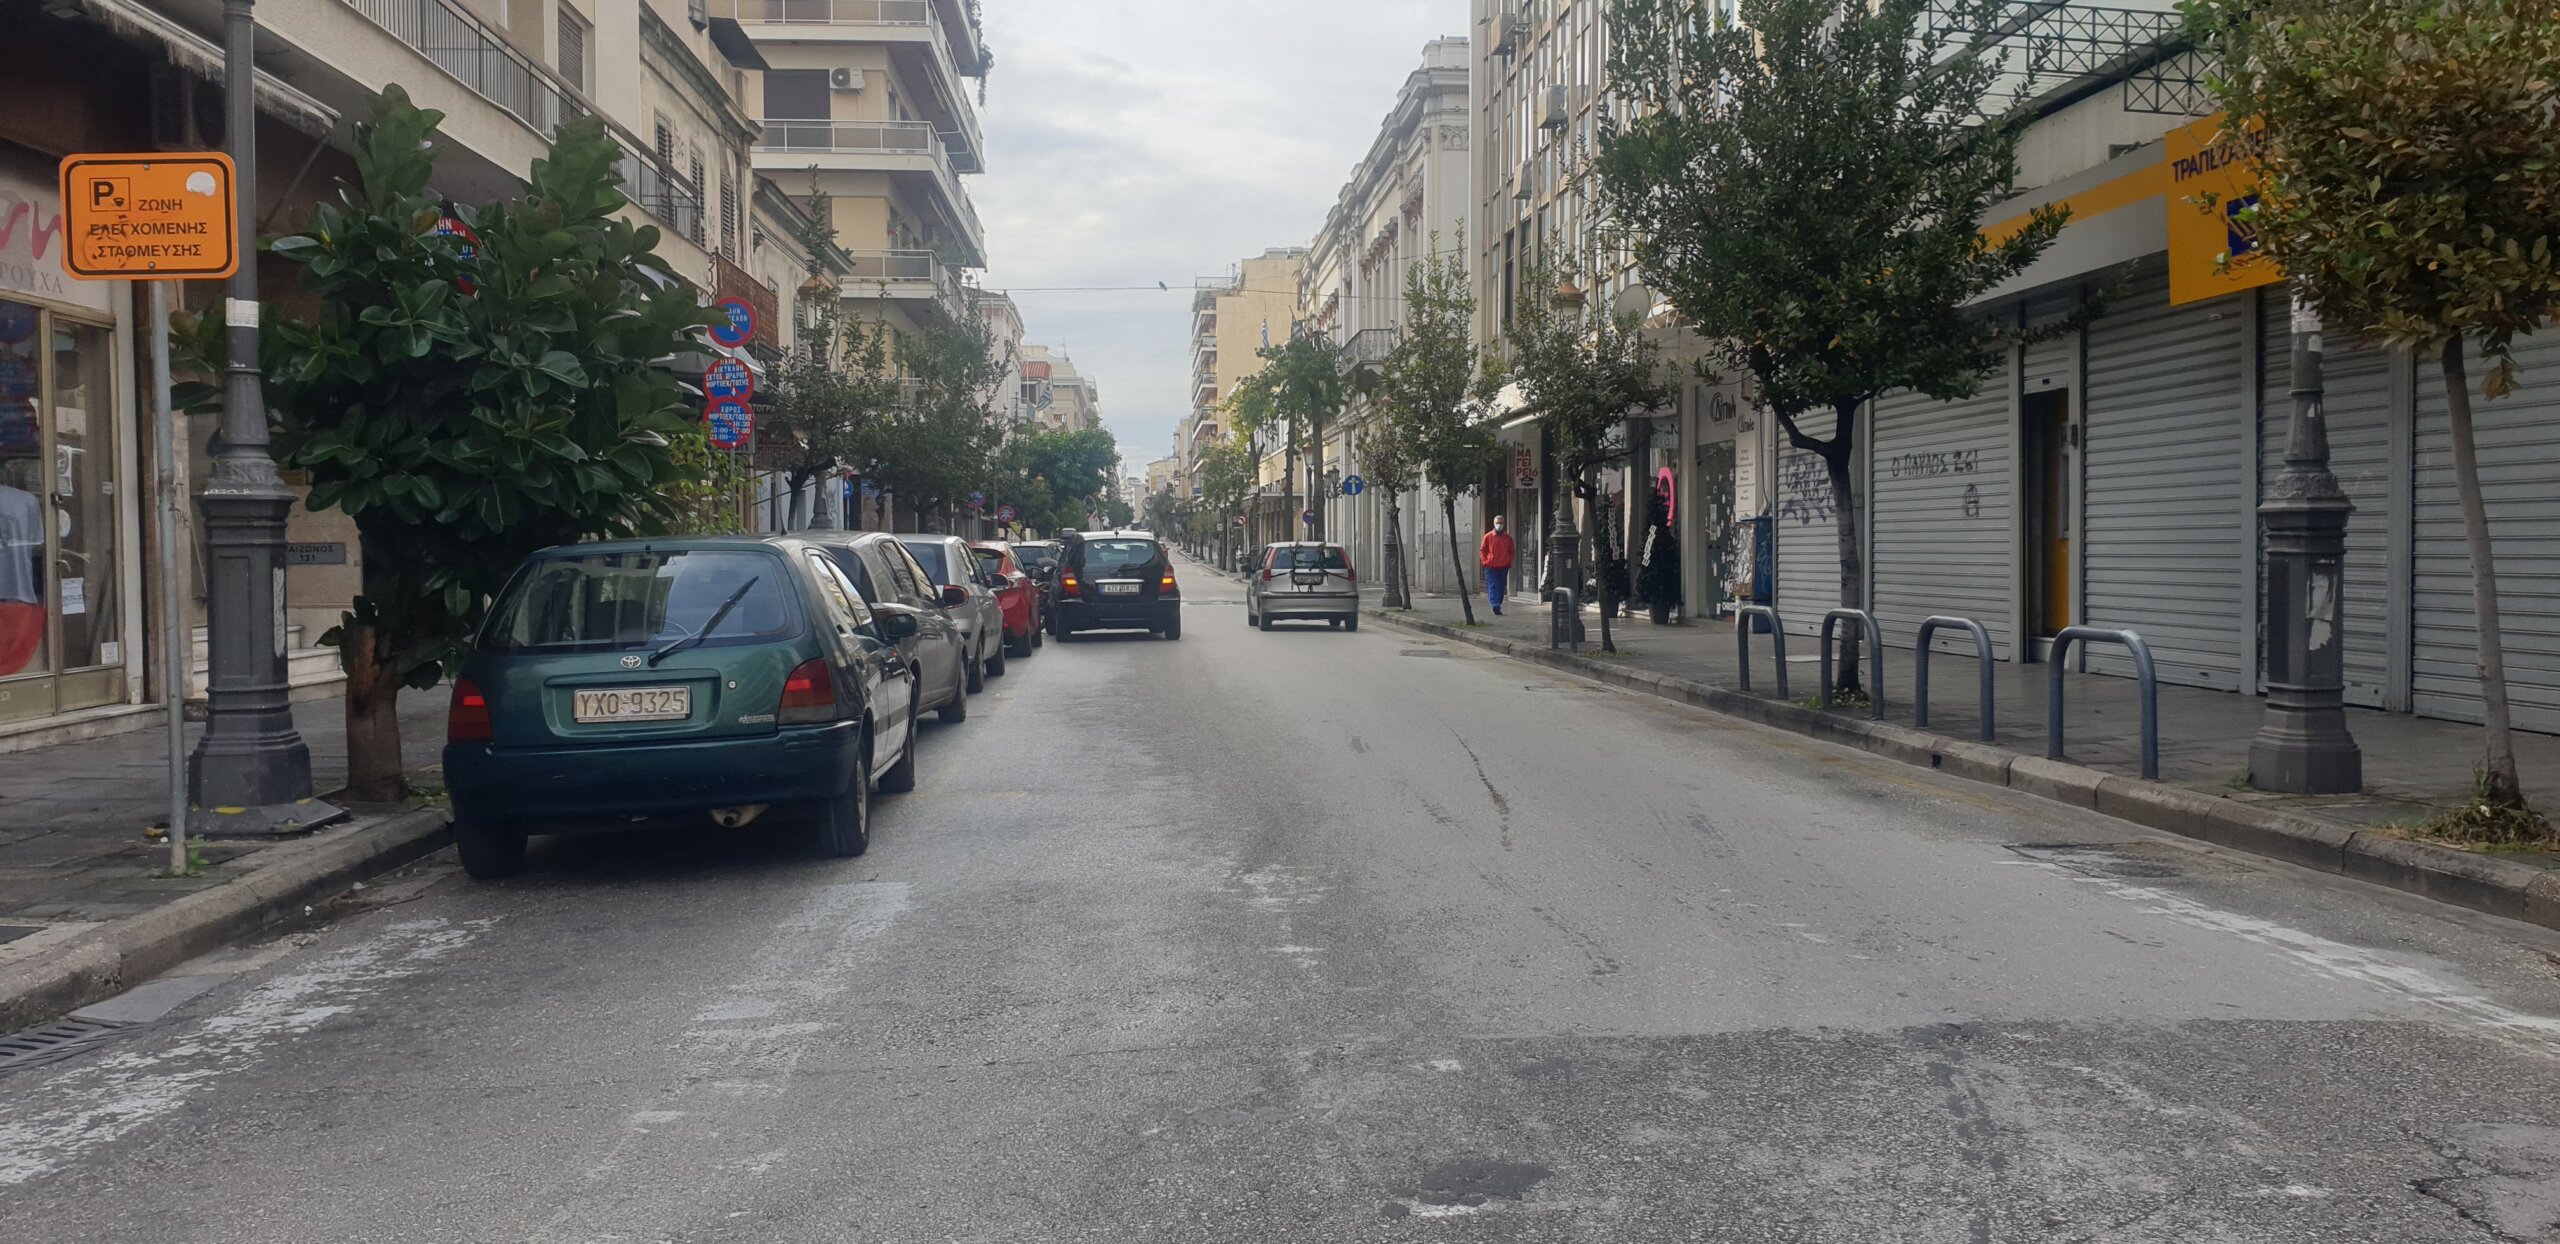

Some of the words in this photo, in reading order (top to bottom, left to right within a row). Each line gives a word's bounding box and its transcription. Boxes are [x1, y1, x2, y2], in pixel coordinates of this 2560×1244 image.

[93, 181, 115, 206] P
[138, 198, 183, 212] ΖΩΝΗ
[89, 221, 208, 236] ΕΛΕΓΧΟΜΕΝΗΣ
[97, 243, 203, 258] ΣΤΑΘΜΕΥΣΗΣ
[287, 545, 334, 553] ΑΙΖΩΝΟΣ
